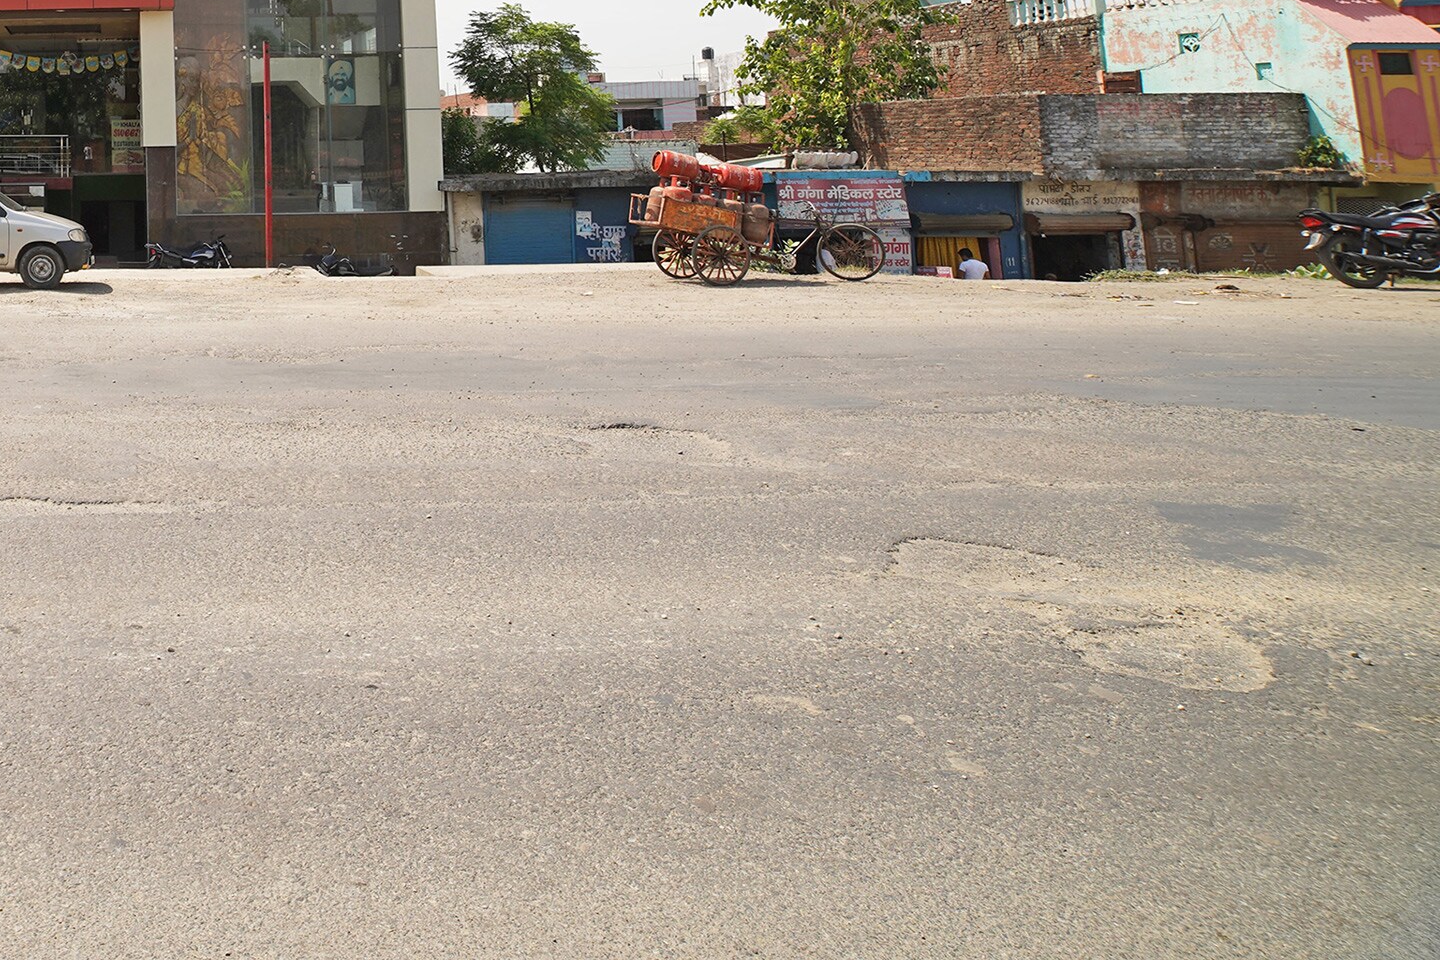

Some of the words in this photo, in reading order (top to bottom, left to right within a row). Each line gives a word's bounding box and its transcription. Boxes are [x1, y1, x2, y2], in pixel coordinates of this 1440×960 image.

[779, 185, 794, 199] श्री
[797, 186, 824, 199] गंगा
[827, 185, 874, 200] मेडिकल
[876, 185, 902, 199] स्टोर
[884, 238, 910, 255] गंगा
[895, 257, 910, 267] स्टोर
